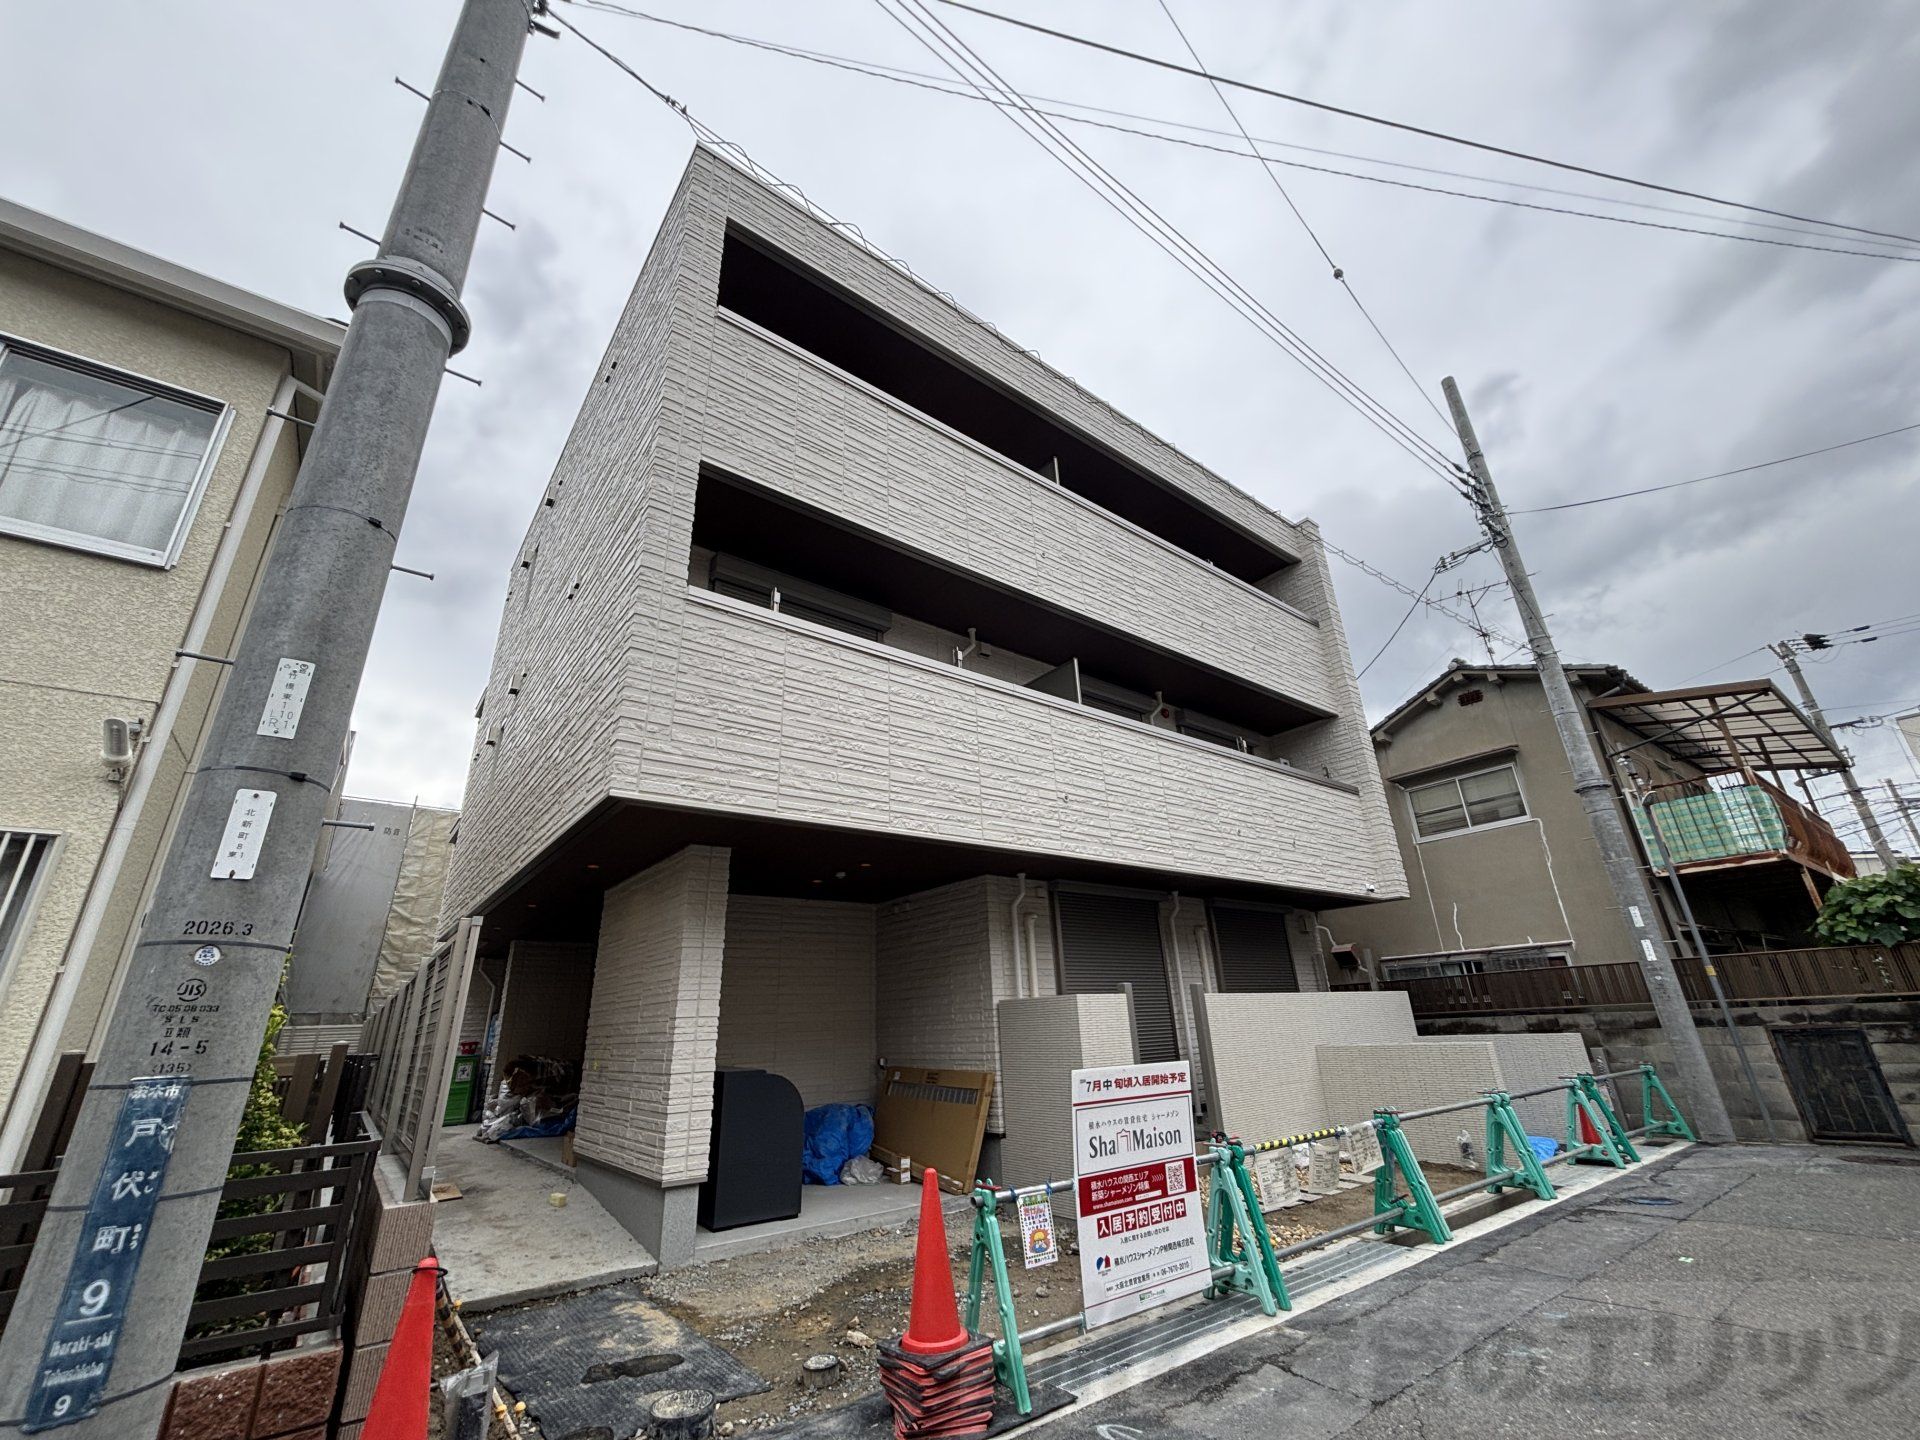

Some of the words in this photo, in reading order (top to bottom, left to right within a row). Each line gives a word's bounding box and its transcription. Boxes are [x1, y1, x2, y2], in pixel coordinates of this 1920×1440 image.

[183, 920, 254, 936] 2026.3
[1099, 1200, 1186, 1237] 入居予約受付中
[80, 1279, 111, 1316] 9
[53, 1394, 72, 1417] 9
